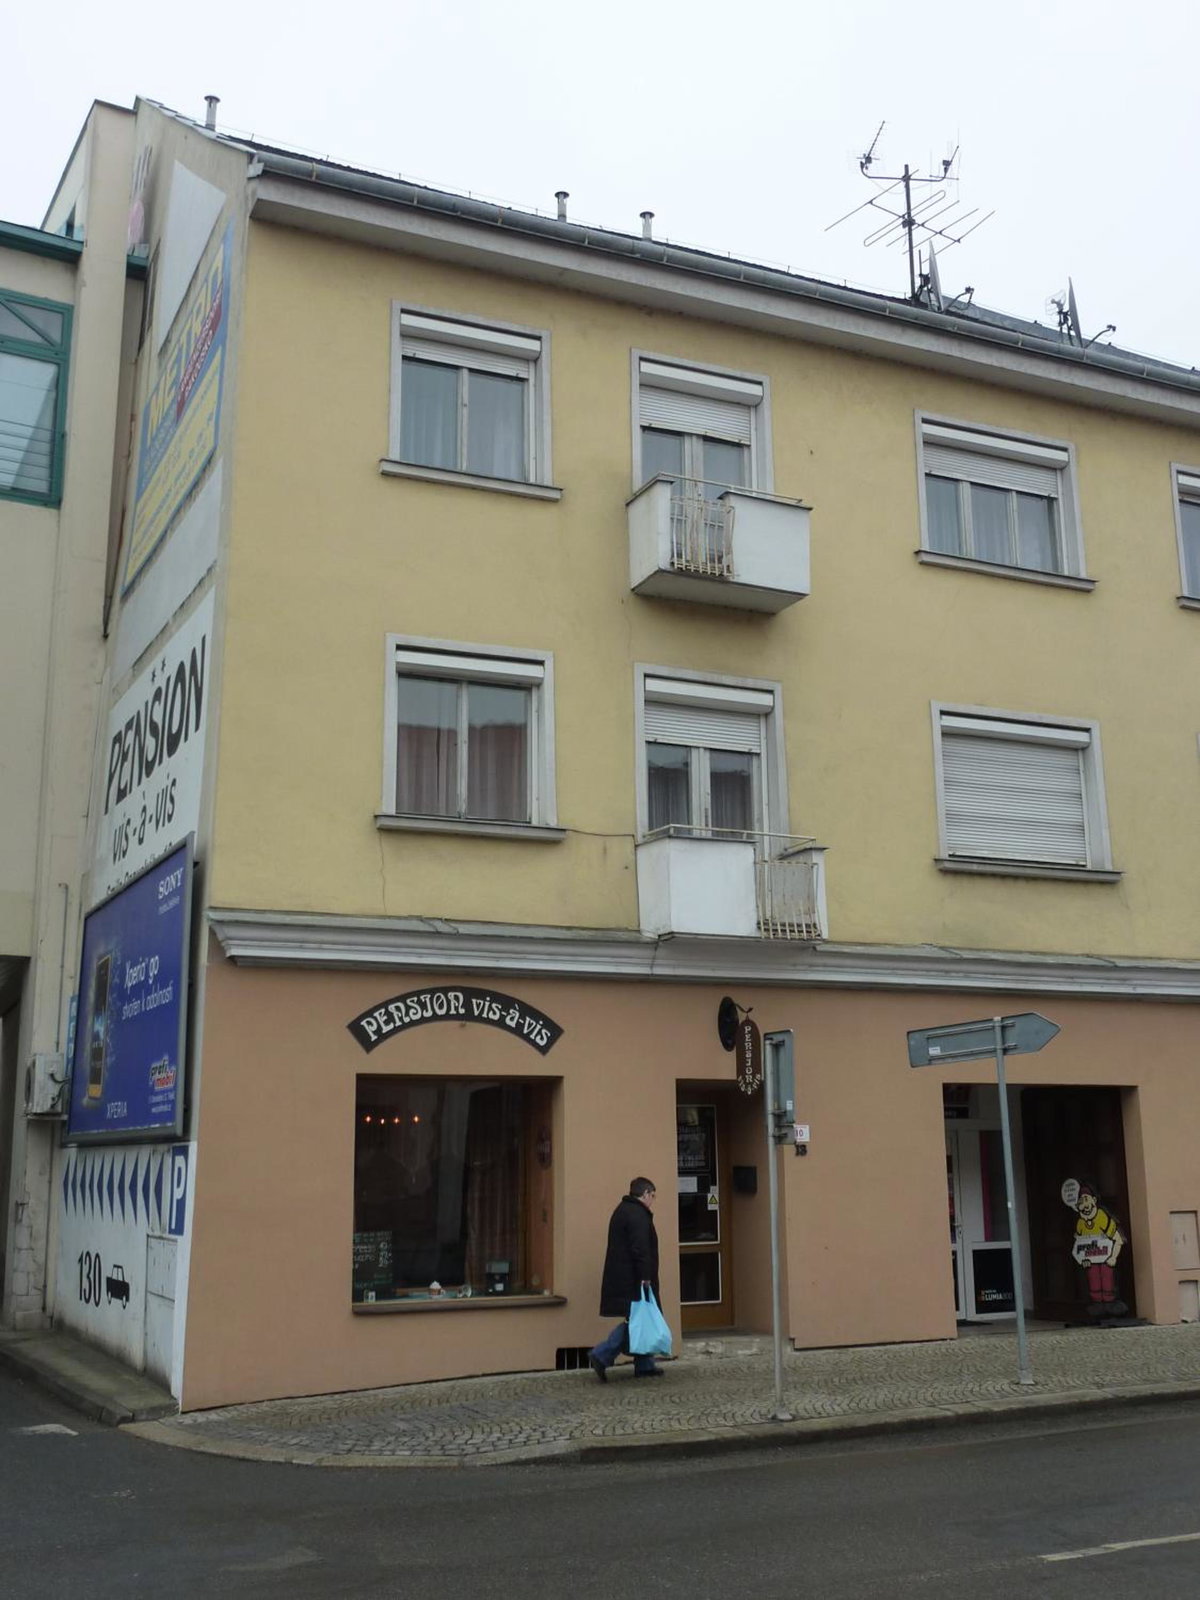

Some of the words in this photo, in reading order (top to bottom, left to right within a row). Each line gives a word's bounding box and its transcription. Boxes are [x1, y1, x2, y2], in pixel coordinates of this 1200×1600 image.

[104, 634, 207, 816] PENSION
[111, 773, 177, 865] vis-à-vis
[158, 866, 184, 900] SONY
[150, 955, 159, 984] go
[471, 996, 551, 1047] vis-à-vis
[107, 1102, 127, 1119] XPERIA
[171, 1154, 187, 1230] P
[77, 1249, 102, 1308] 130
